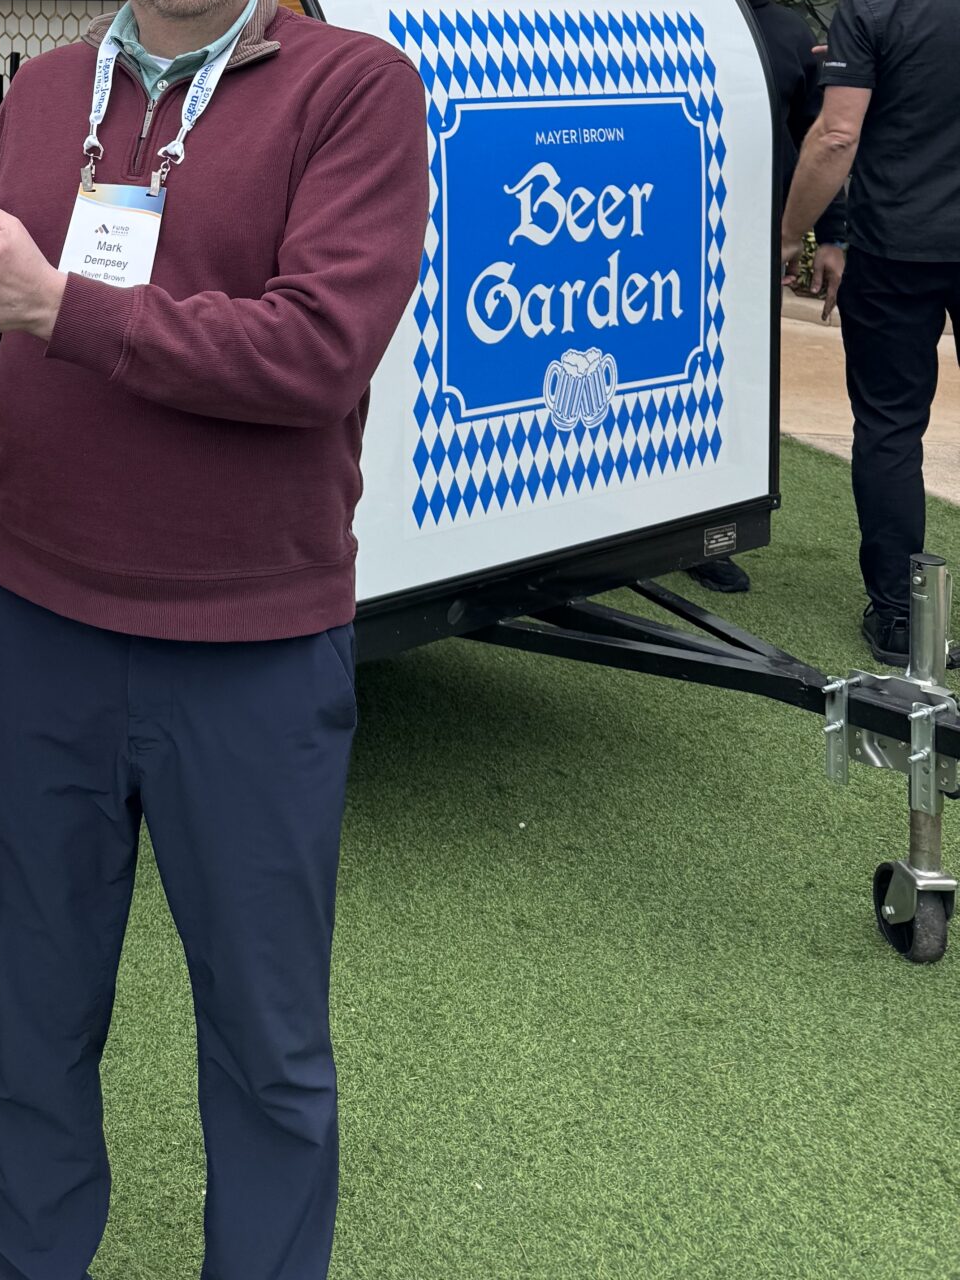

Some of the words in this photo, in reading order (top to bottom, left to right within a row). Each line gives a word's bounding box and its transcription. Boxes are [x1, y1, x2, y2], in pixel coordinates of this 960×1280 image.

[503, 161, 654, 246] Beer
[96, 240, 123, 253] Mark
[84, 254, 129, 271] Dempsey
[103, 272, 126, 283] Brown
[466, 249, 684, 345] Garden
